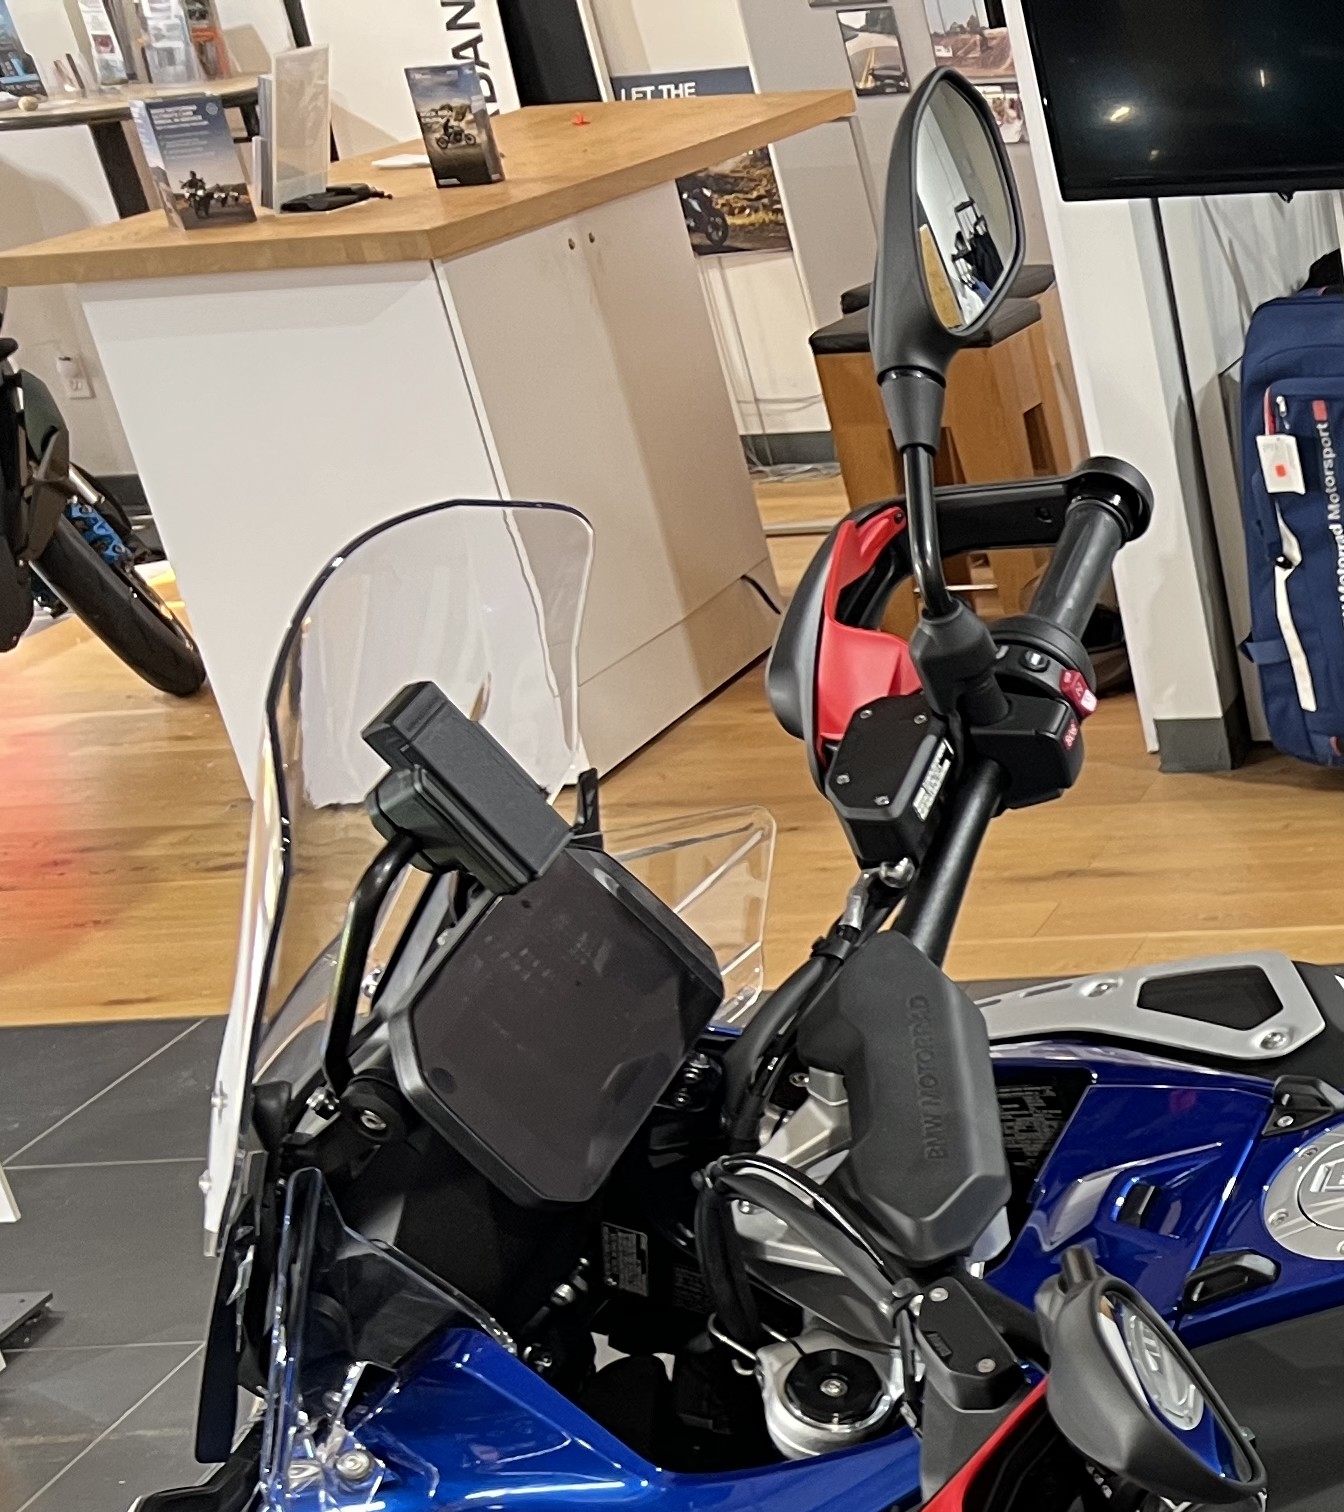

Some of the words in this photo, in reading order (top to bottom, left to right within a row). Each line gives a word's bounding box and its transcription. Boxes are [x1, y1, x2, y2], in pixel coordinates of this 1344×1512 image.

[658, 81, 697, 99] THE
[1316, 421, 1342, 520] Motorsport
[922, 1112, 949, 1162] BMW
